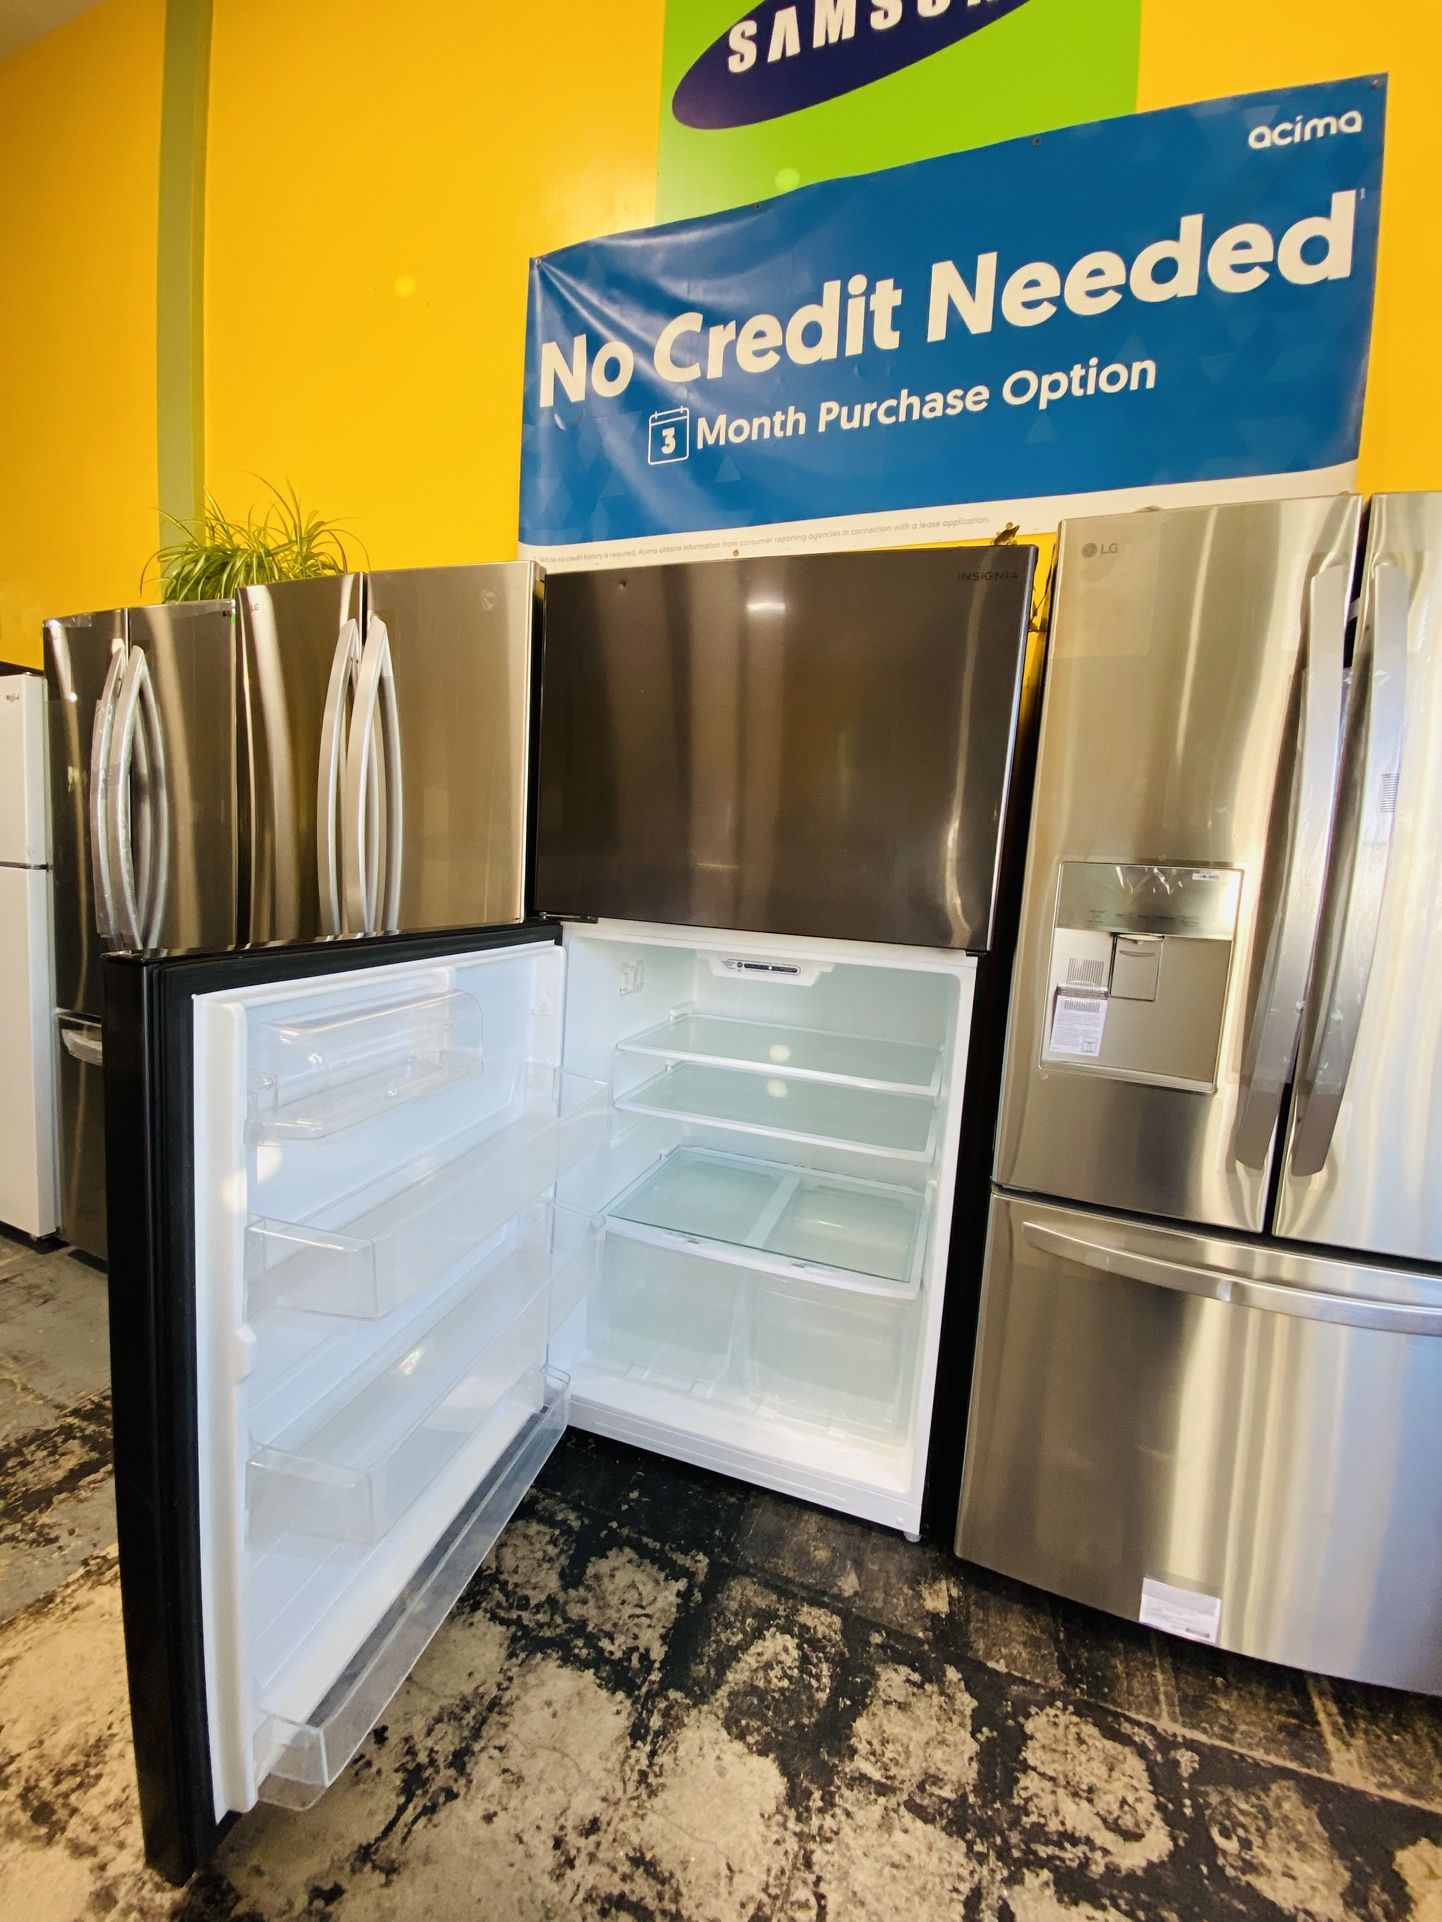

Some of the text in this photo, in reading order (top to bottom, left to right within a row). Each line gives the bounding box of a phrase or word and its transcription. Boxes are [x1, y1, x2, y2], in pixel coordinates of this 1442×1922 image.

[728, 0, 998, 74] SAMS
[1248, 110, 1362, 149] acima
[539, 188, 1357, 408] No Credit Needed
[661, 356, 1157, 455] 3 Month Purchase Option
[683, 541, 721, 551] information
[722, 540, 739, 548] from
[740, 538, 773, 547] consumer
[774, 533, 807, 544] reporting
[808, 529, 841, 541] agencies
[842, 529, 849, 537] in
[850, 524, 892, 536] connection
[893, 522, 910, 532] with
[911, 523, 918, 531] a
[919, 520, 940, 530] lease
[942, 515, 990, 528] application.
[1100, 543, 1119, 555] LG
[958, 570, 1019, 583] INSIGNIA
